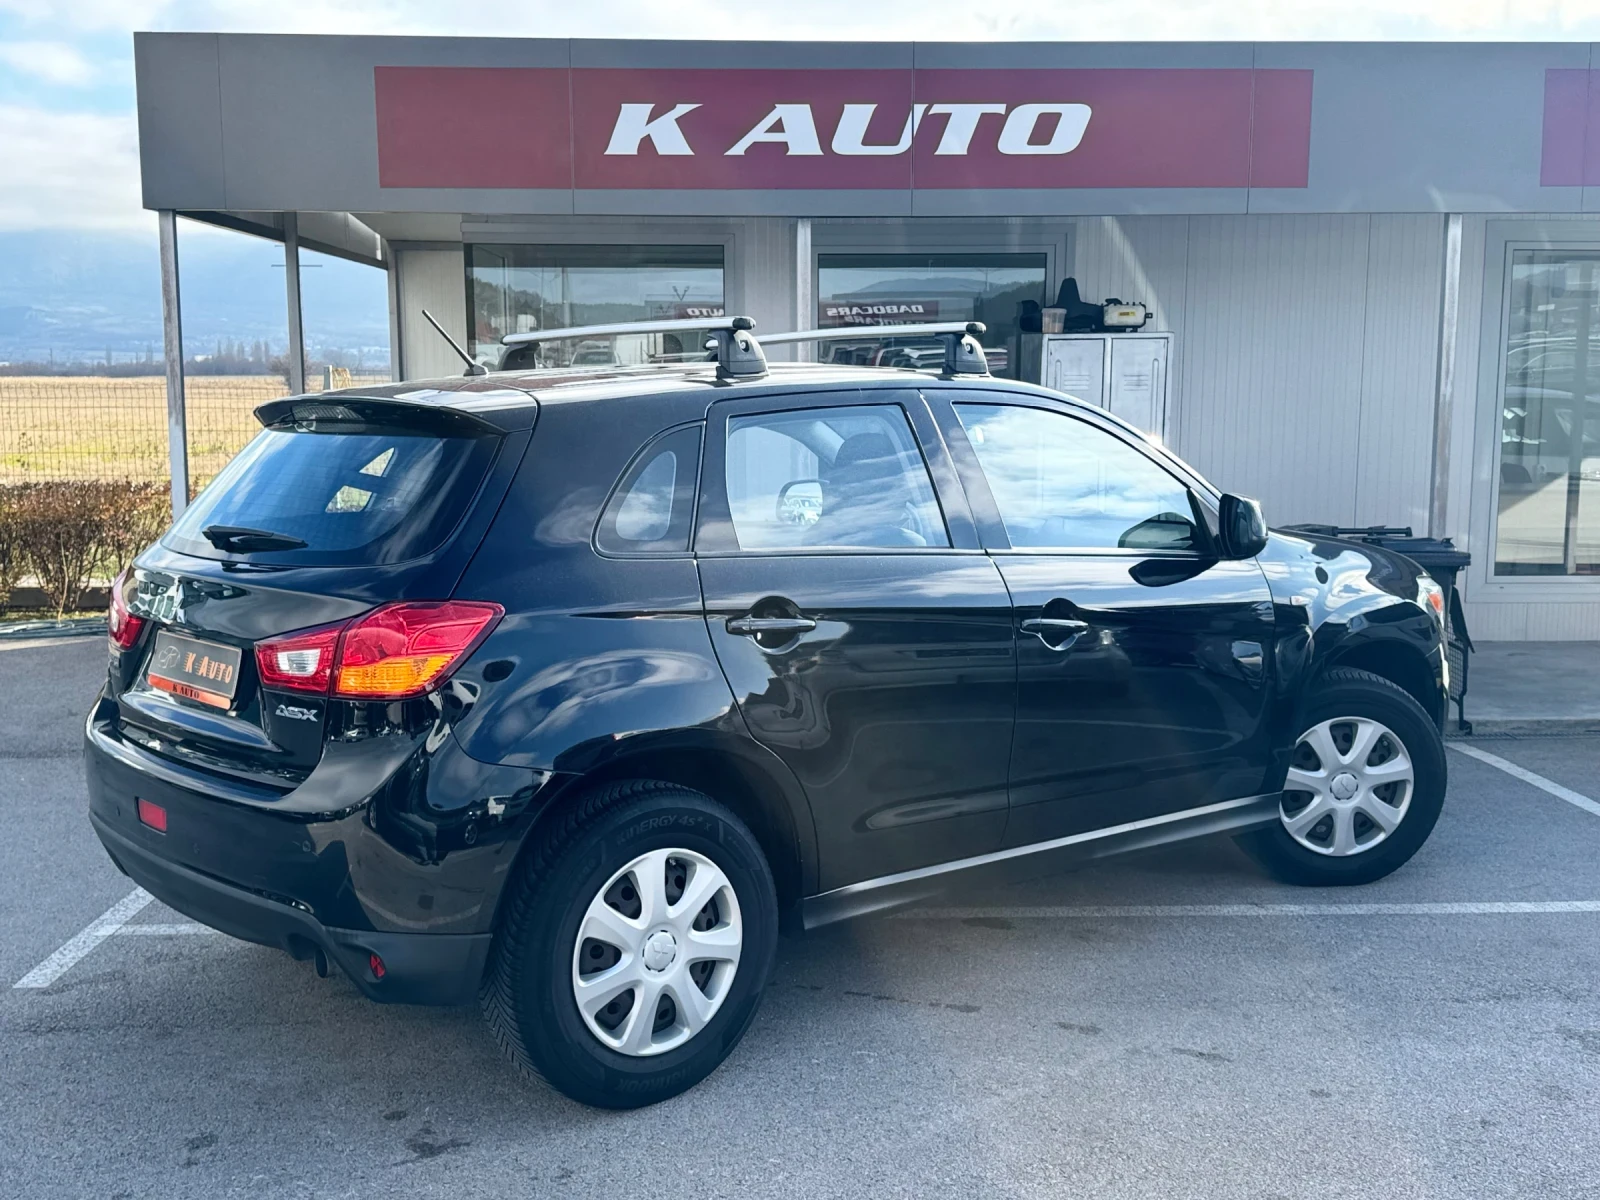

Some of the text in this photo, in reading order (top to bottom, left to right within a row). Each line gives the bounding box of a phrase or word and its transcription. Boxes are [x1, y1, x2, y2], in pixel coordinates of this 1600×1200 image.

[604, 103, 1093, 156] K AUTO
[183, 651, 197, 674] K
[172, 682, 200, 699] K AUTO
[275, 704, 318, 722] ASX
